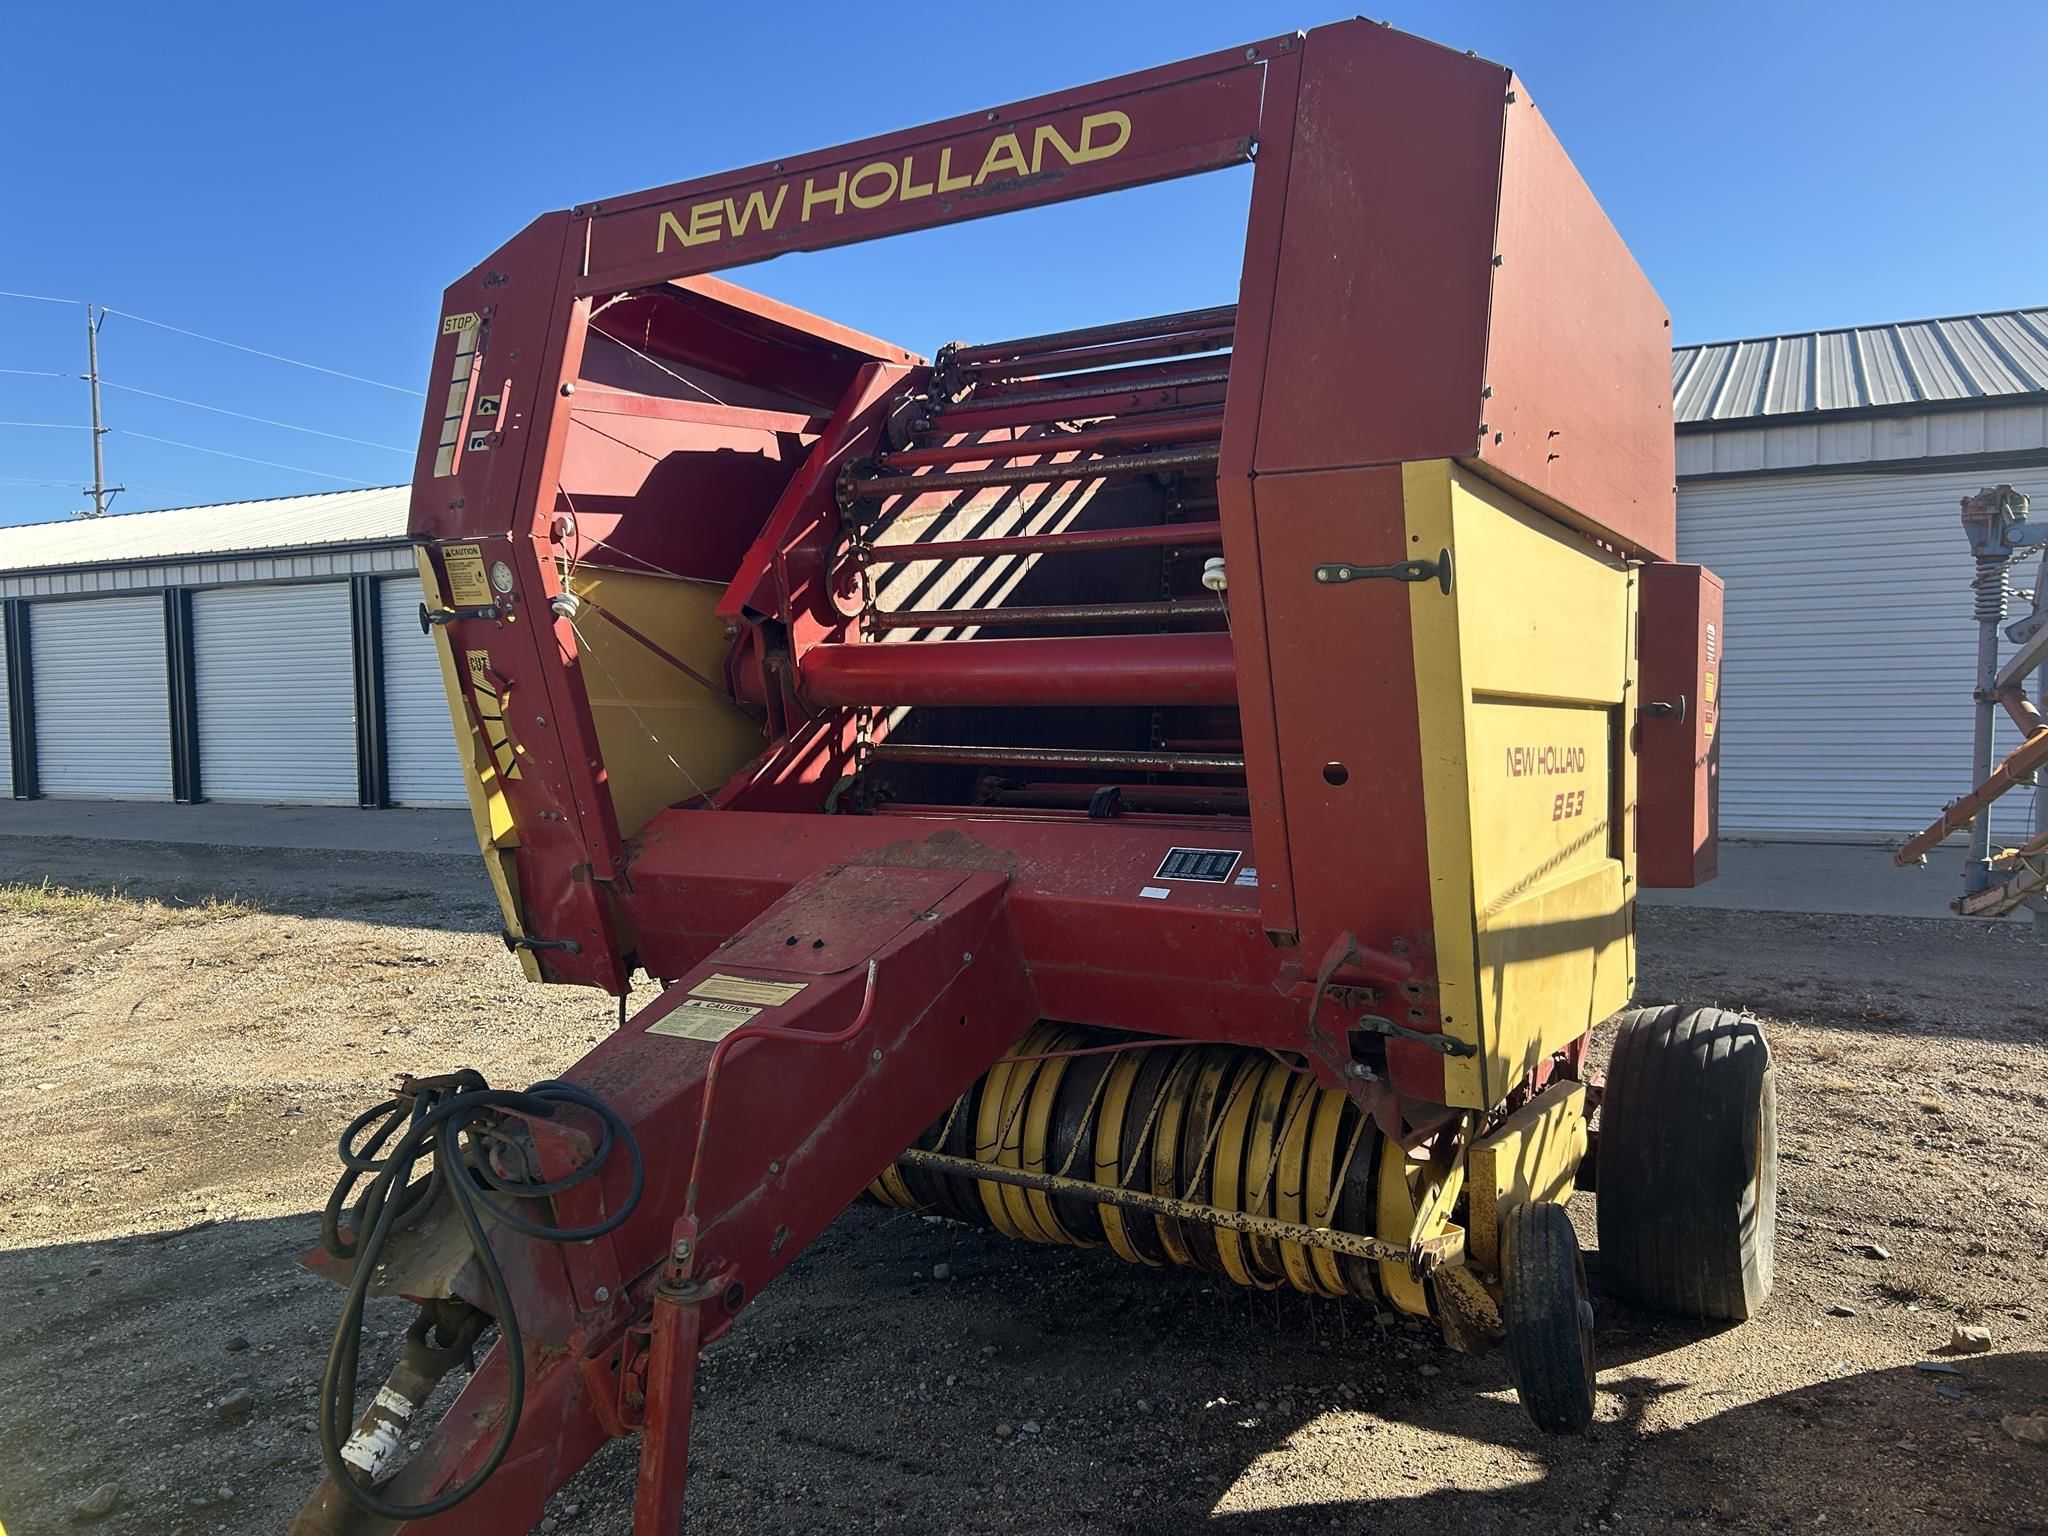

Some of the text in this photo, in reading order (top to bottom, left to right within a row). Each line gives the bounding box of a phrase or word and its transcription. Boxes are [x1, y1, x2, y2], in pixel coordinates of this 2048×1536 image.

[656, 110, 1132, 253] NEW HOLLAND
[445, 316, 472, 331] STOP
[451, 547, 478, 556] CAUTION
[470, 657, 487, 671] CUT
[1506, 745, 1585, 777] NEW HOLLAND
[1552, 790, 1585, 821] 853
[706, 1002, 752, 1013] CAUTION
